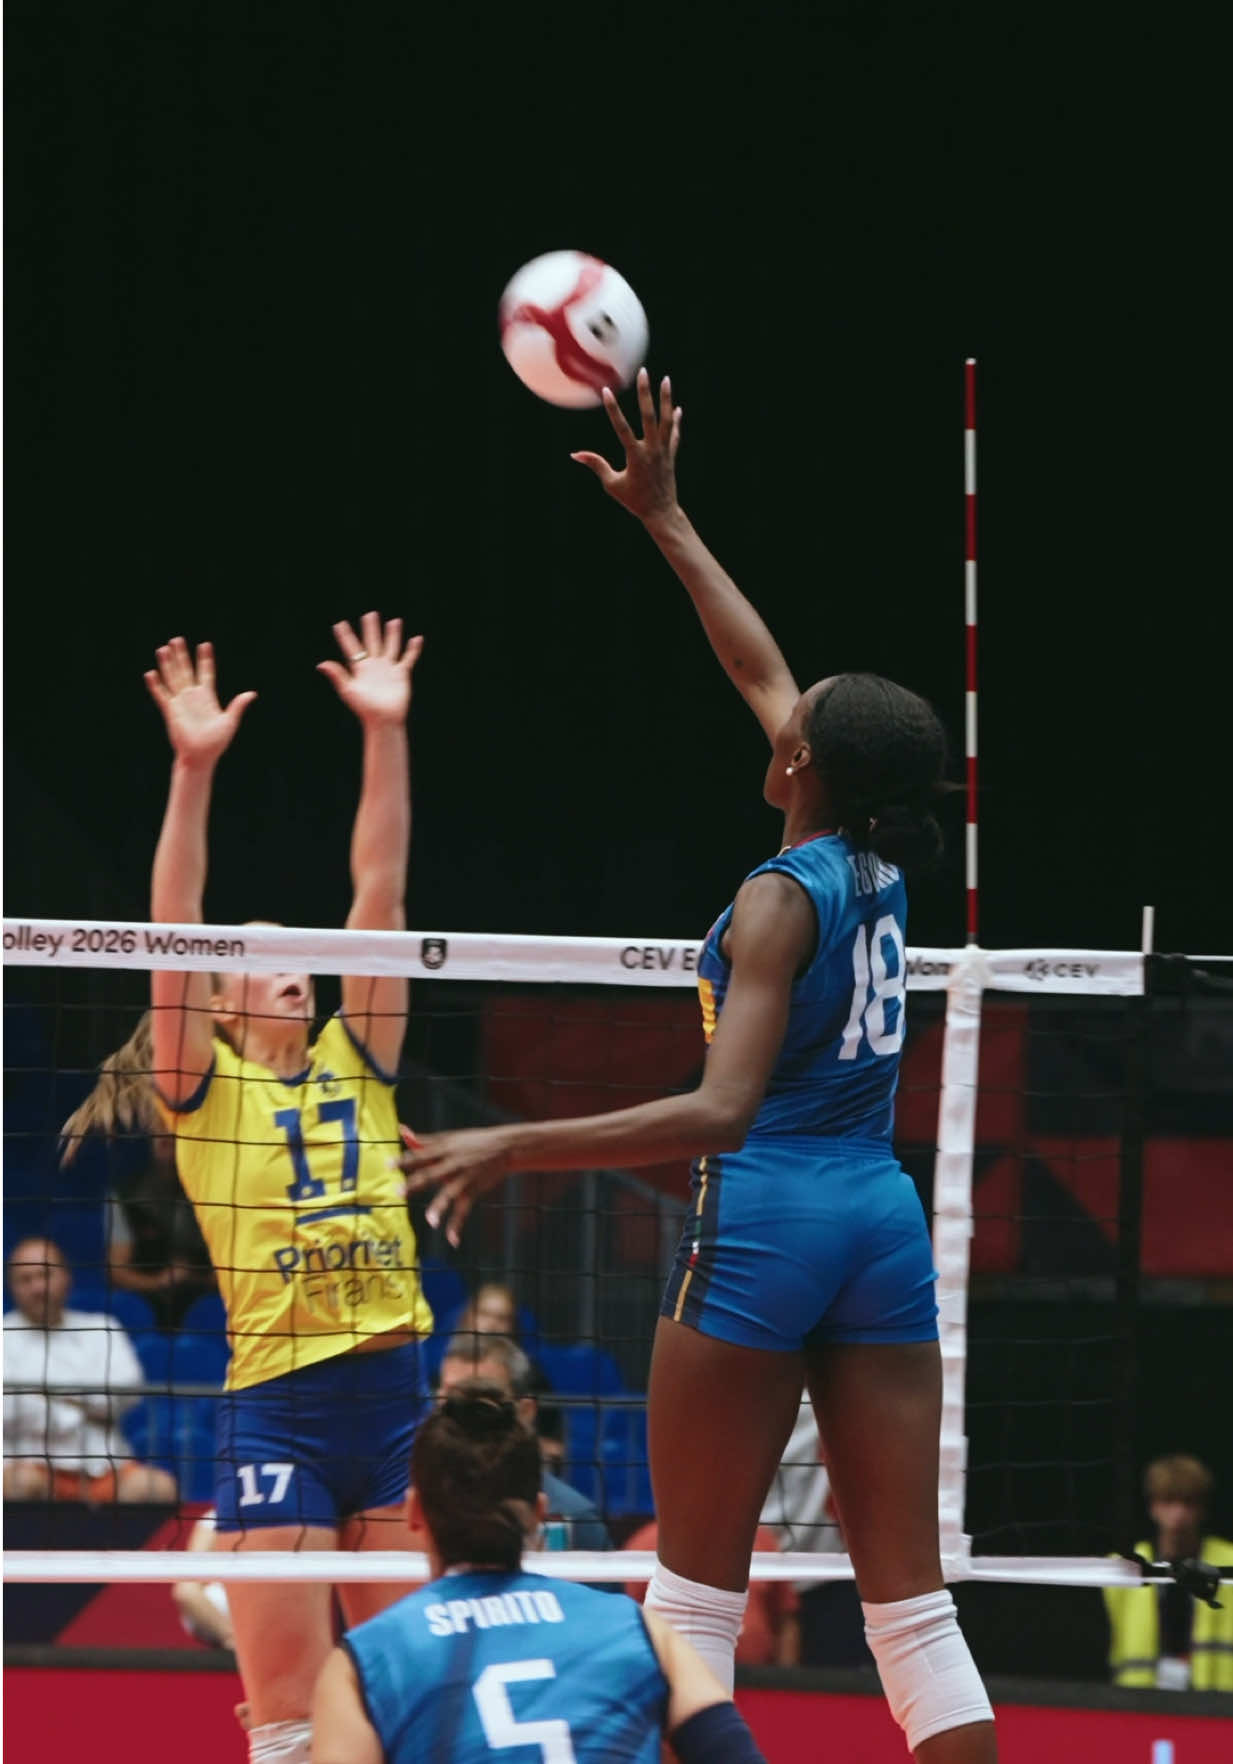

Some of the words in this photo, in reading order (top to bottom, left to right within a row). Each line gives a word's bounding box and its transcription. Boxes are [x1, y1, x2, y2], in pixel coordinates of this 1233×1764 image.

[72, 928, 136, 953] 2026
[144, 930, 245, 957] Women
[620, 946, 676, 970] CEV
[837, 913, 906, 1060] 18
[1053, 963, 1100, 979] CEV
[274, 1098, 359, 1202] 17
[236, 1463, 295, 1507] 17
[423, 1590, 566, 1637] SPIRITO
[471, 1658, 578, 1764] 5
